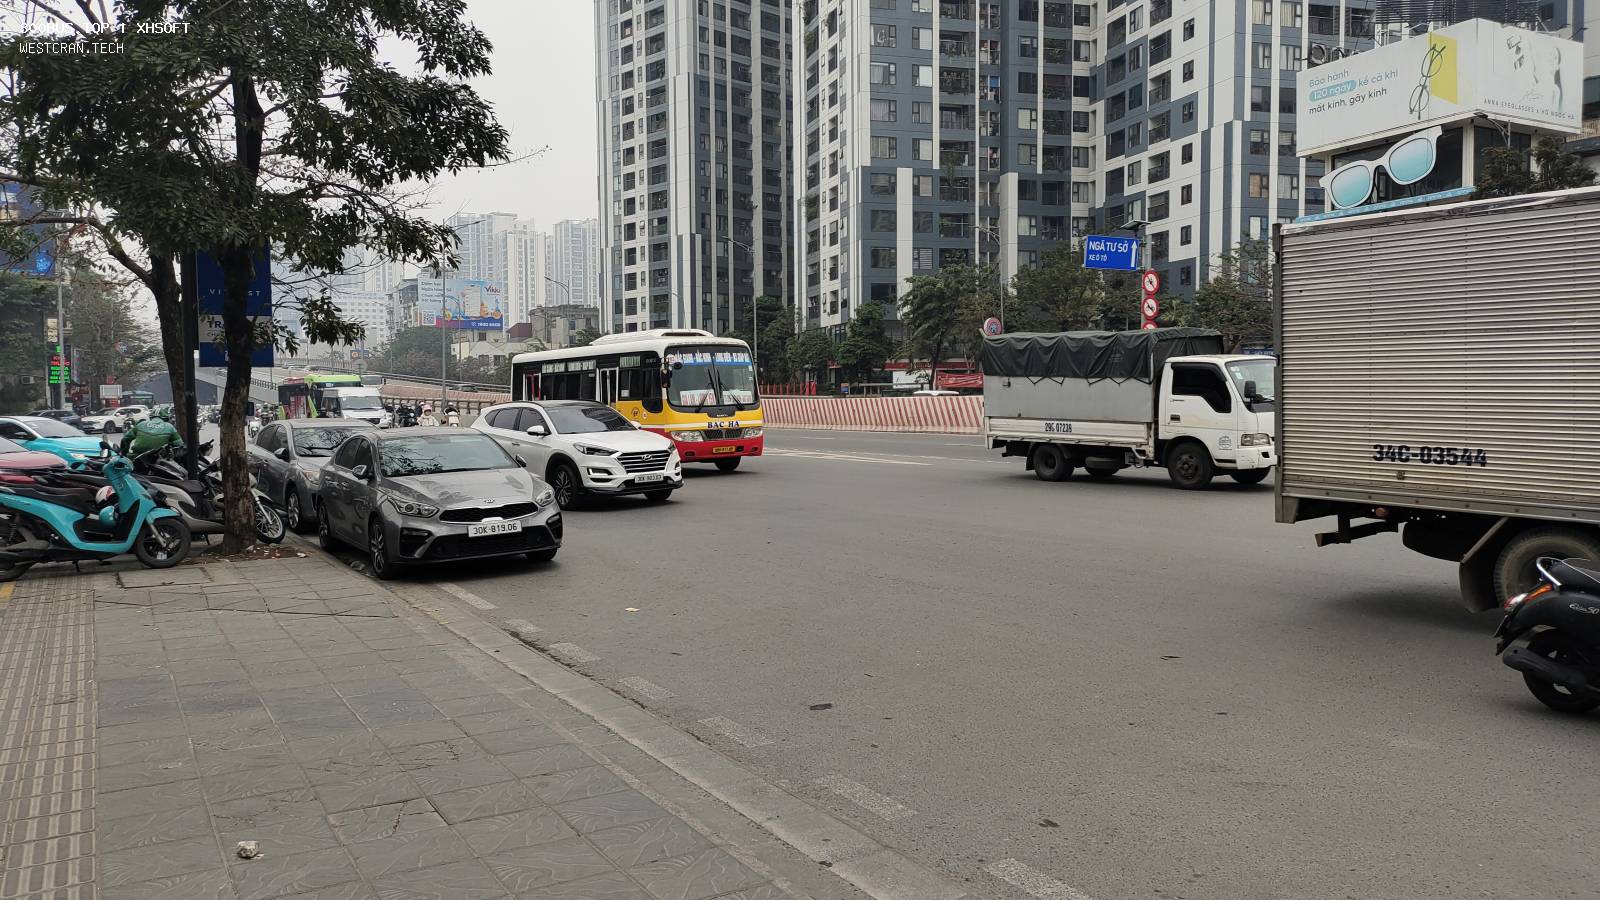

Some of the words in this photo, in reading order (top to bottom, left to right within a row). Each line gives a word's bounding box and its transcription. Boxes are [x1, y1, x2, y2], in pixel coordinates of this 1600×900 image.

[1313, 90, 1328, 100] 120
[1384, 68, 1399, 81] khi
[1327, 69, 1349, 83] hành
[1349, 93, 1366, 106] gãy
[1368, 86, 1387, 99] kính
[1484, 97, 1499, 107] ANNA
[1501, 101, 1535, 113] EYEGLASSES
[1089, 240, 1105, 252] NGÃ
[1106, 242, 1117, 252] TƯ
[1118, 240, 1129, 253] SỞ
[484, 283, 501, 294] Vikki
[1372, 444, 1488, 468] 34C-03544
